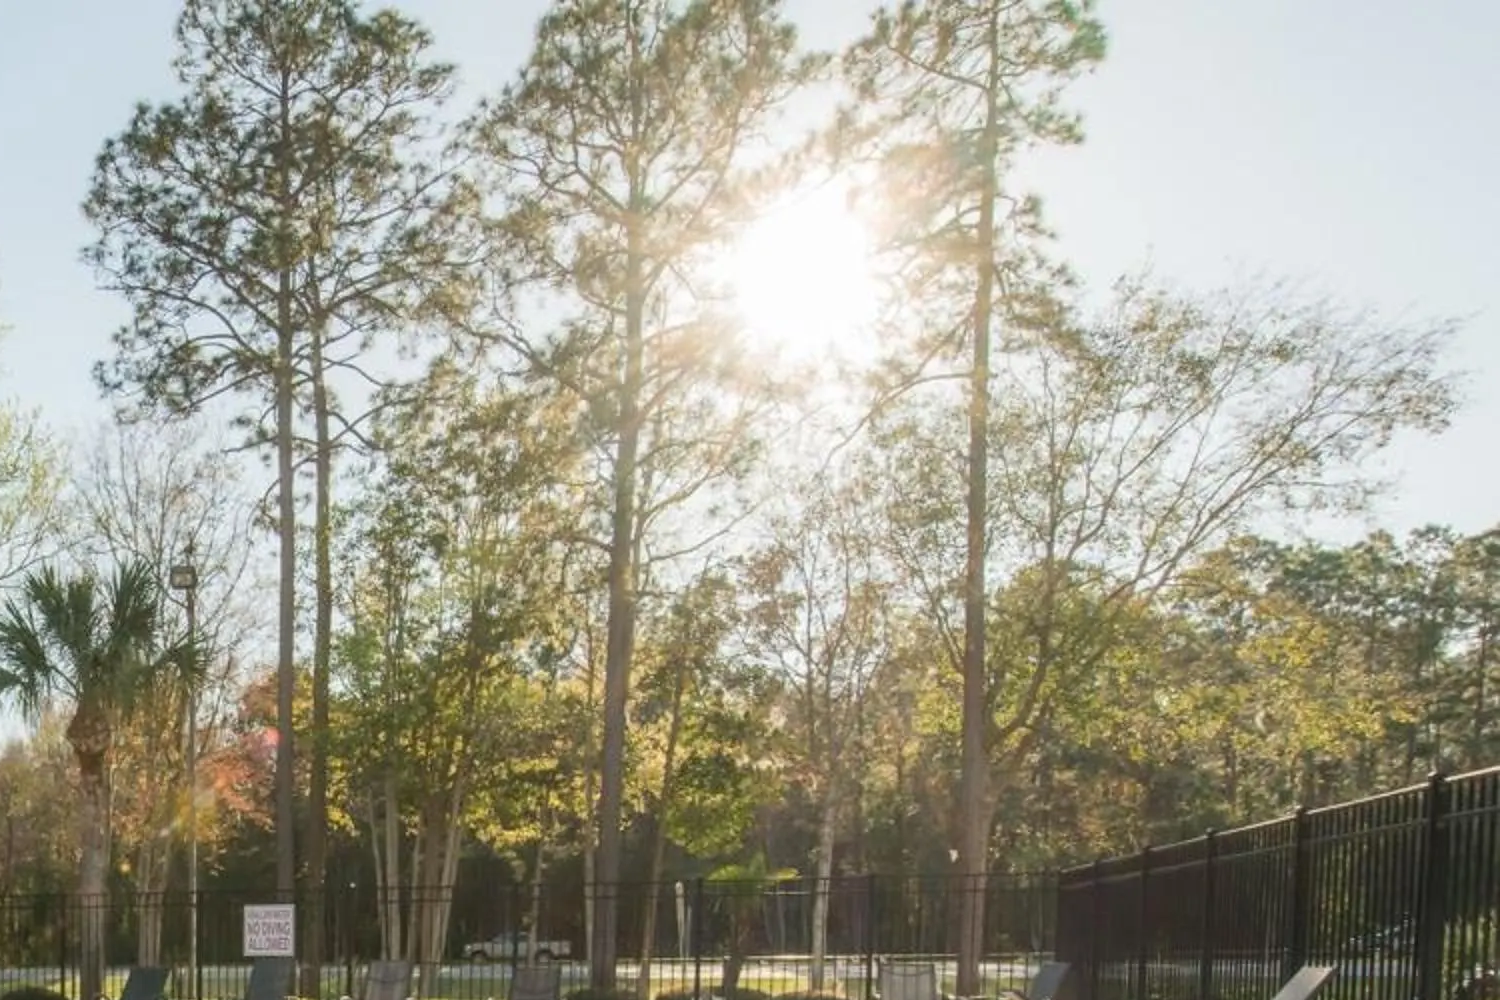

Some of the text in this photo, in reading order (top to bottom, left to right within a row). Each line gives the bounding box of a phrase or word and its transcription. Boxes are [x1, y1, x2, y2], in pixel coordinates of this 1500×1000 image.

[248, 921, 290, 936] NO DIVING
[249, 937, 289, 950] ALLOWED
